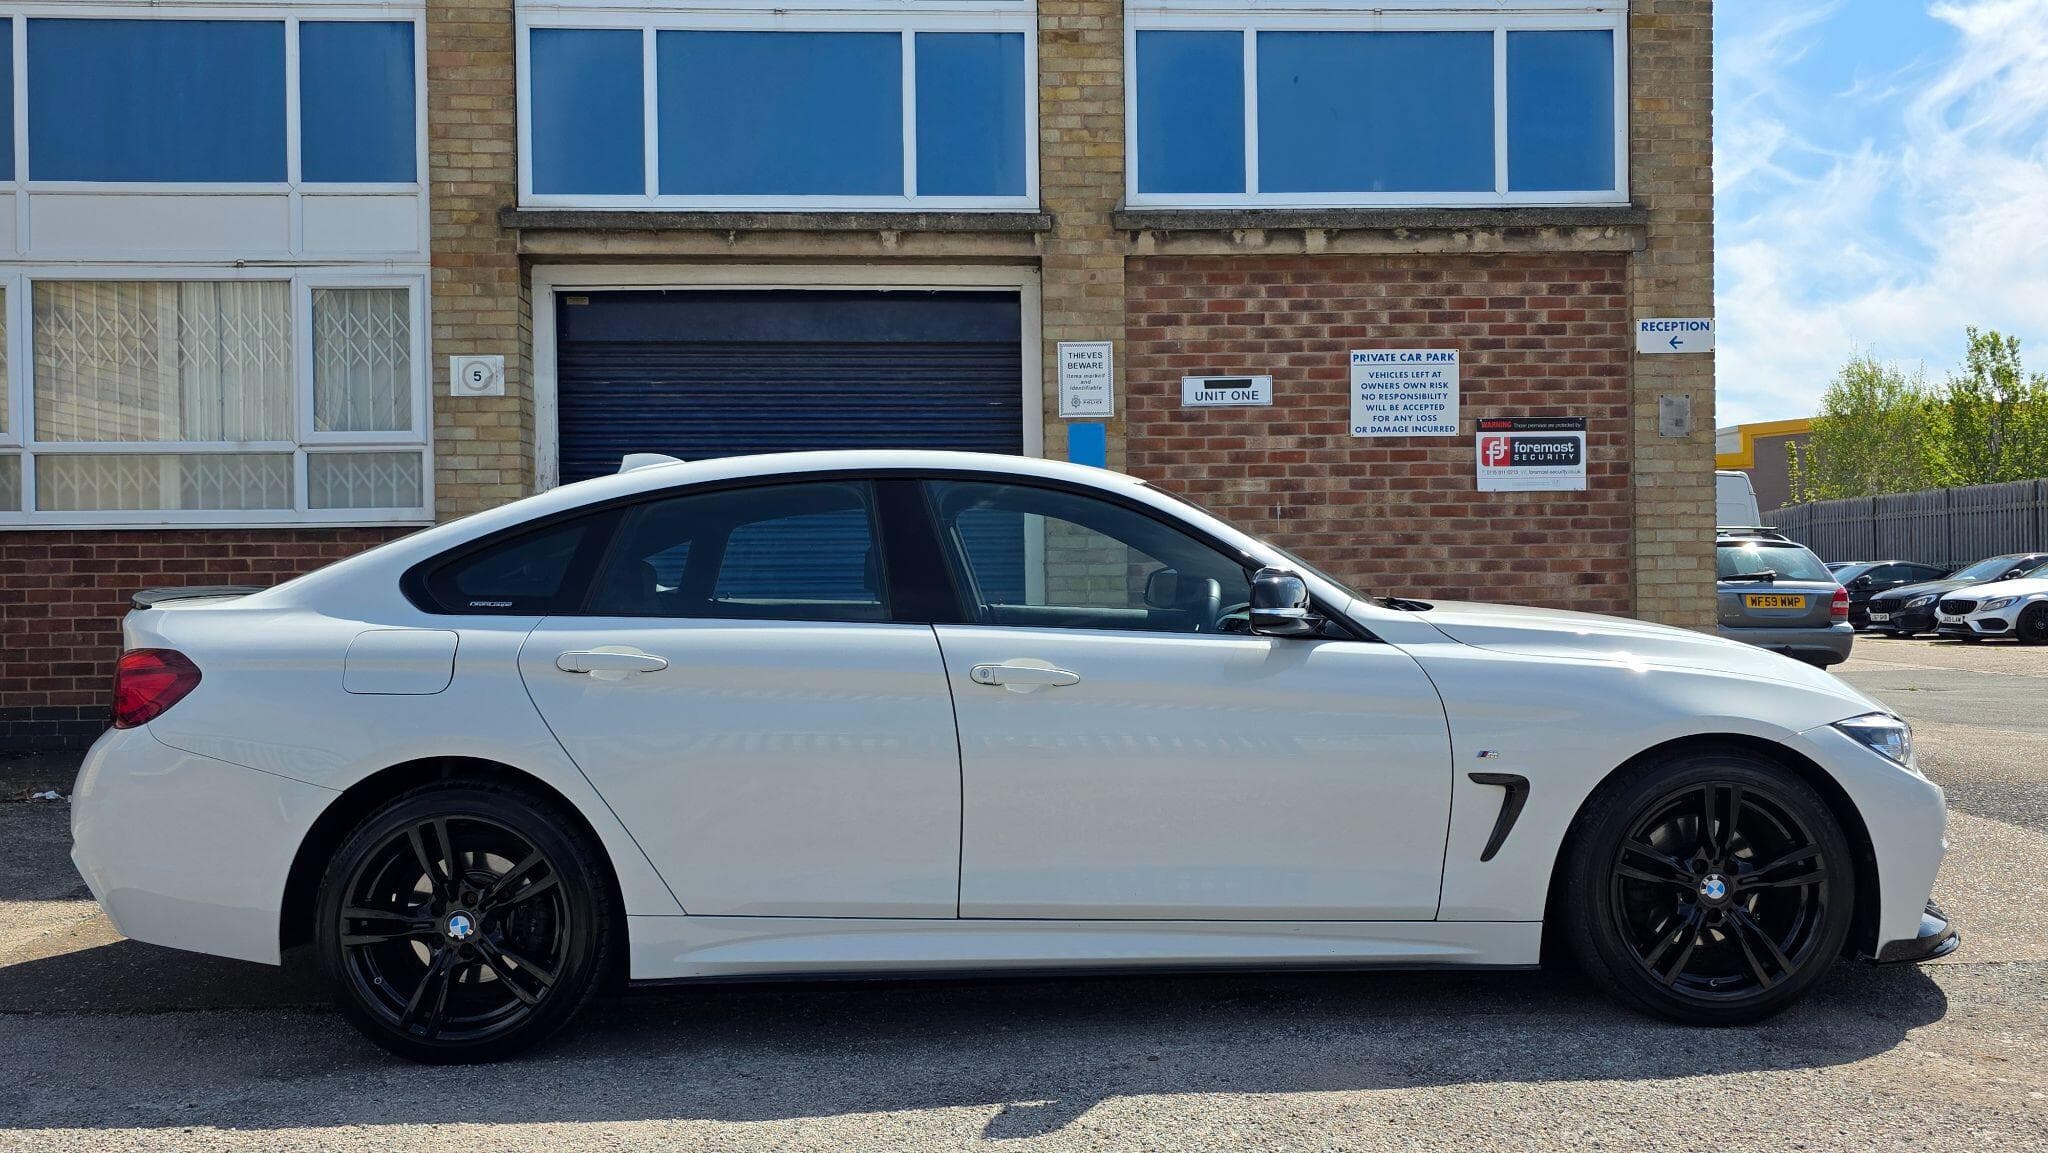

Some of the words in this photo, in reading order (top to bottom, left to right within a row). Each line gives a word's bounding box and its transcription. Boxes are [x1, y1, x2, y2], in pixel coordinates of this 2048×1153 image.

[1642, 321, 1710, 332] RECEPTION
[1353, 353, 1396, 362] PRIVATE
[1400, 353, 1422, 362] CAR
[1426, 353, 1455, 362] PARK
[474, 371, 482, 381] 5
[1361, 382, 1400, 390] OWNERS
[1195, 391, 1226, 401] UNIT
[1231, 390, 1259, 401] ONE
[1412, 425, 1455, 433] INCURRED
[1514, 442, 1575, 453] foremost
[1751, 596, 1778, 607] WF59
[1780, 596, 1801, 607] WMP
